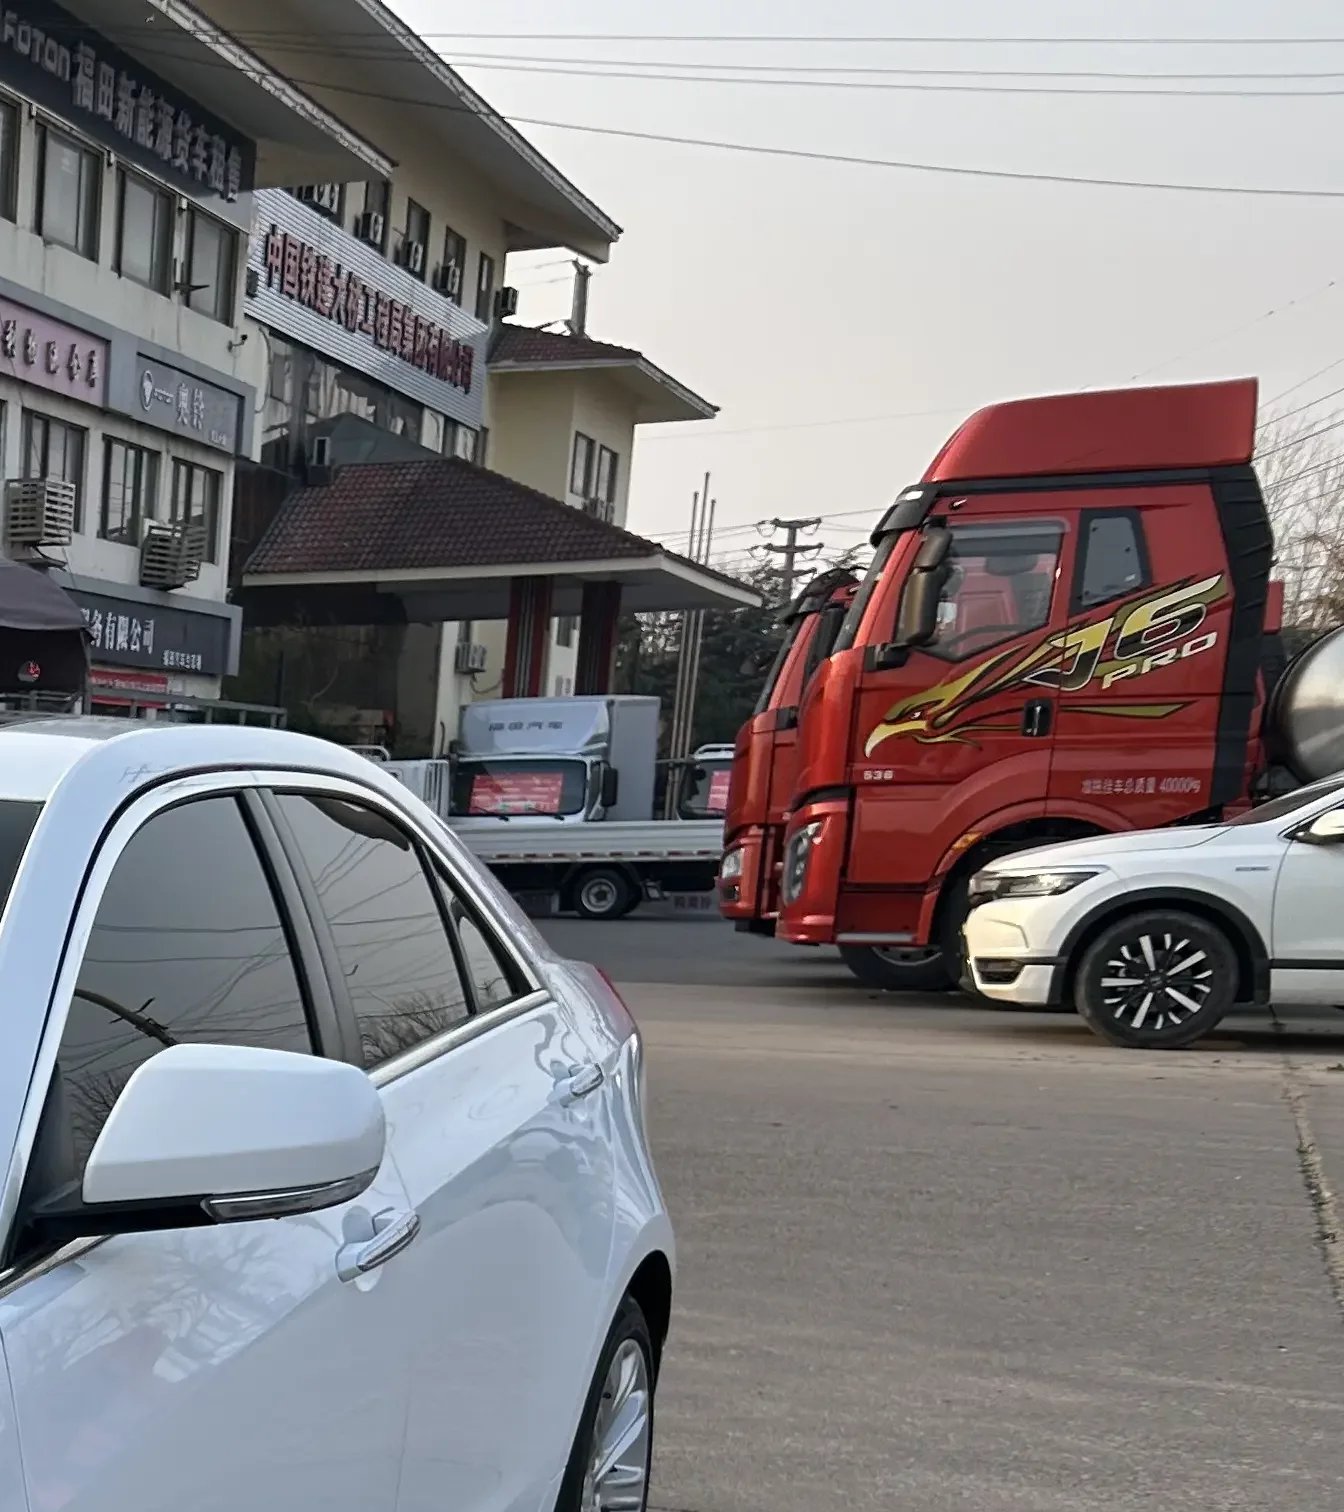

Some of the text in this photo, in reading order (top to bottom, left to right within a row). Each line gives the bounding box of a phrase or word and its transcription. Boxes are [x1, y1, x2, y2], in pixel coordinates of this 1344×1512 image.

[2, 9, 71, 82] FOTON
[1023, 574, 1224, 692] J6
[1101, 631, 1218, 690] PRO
